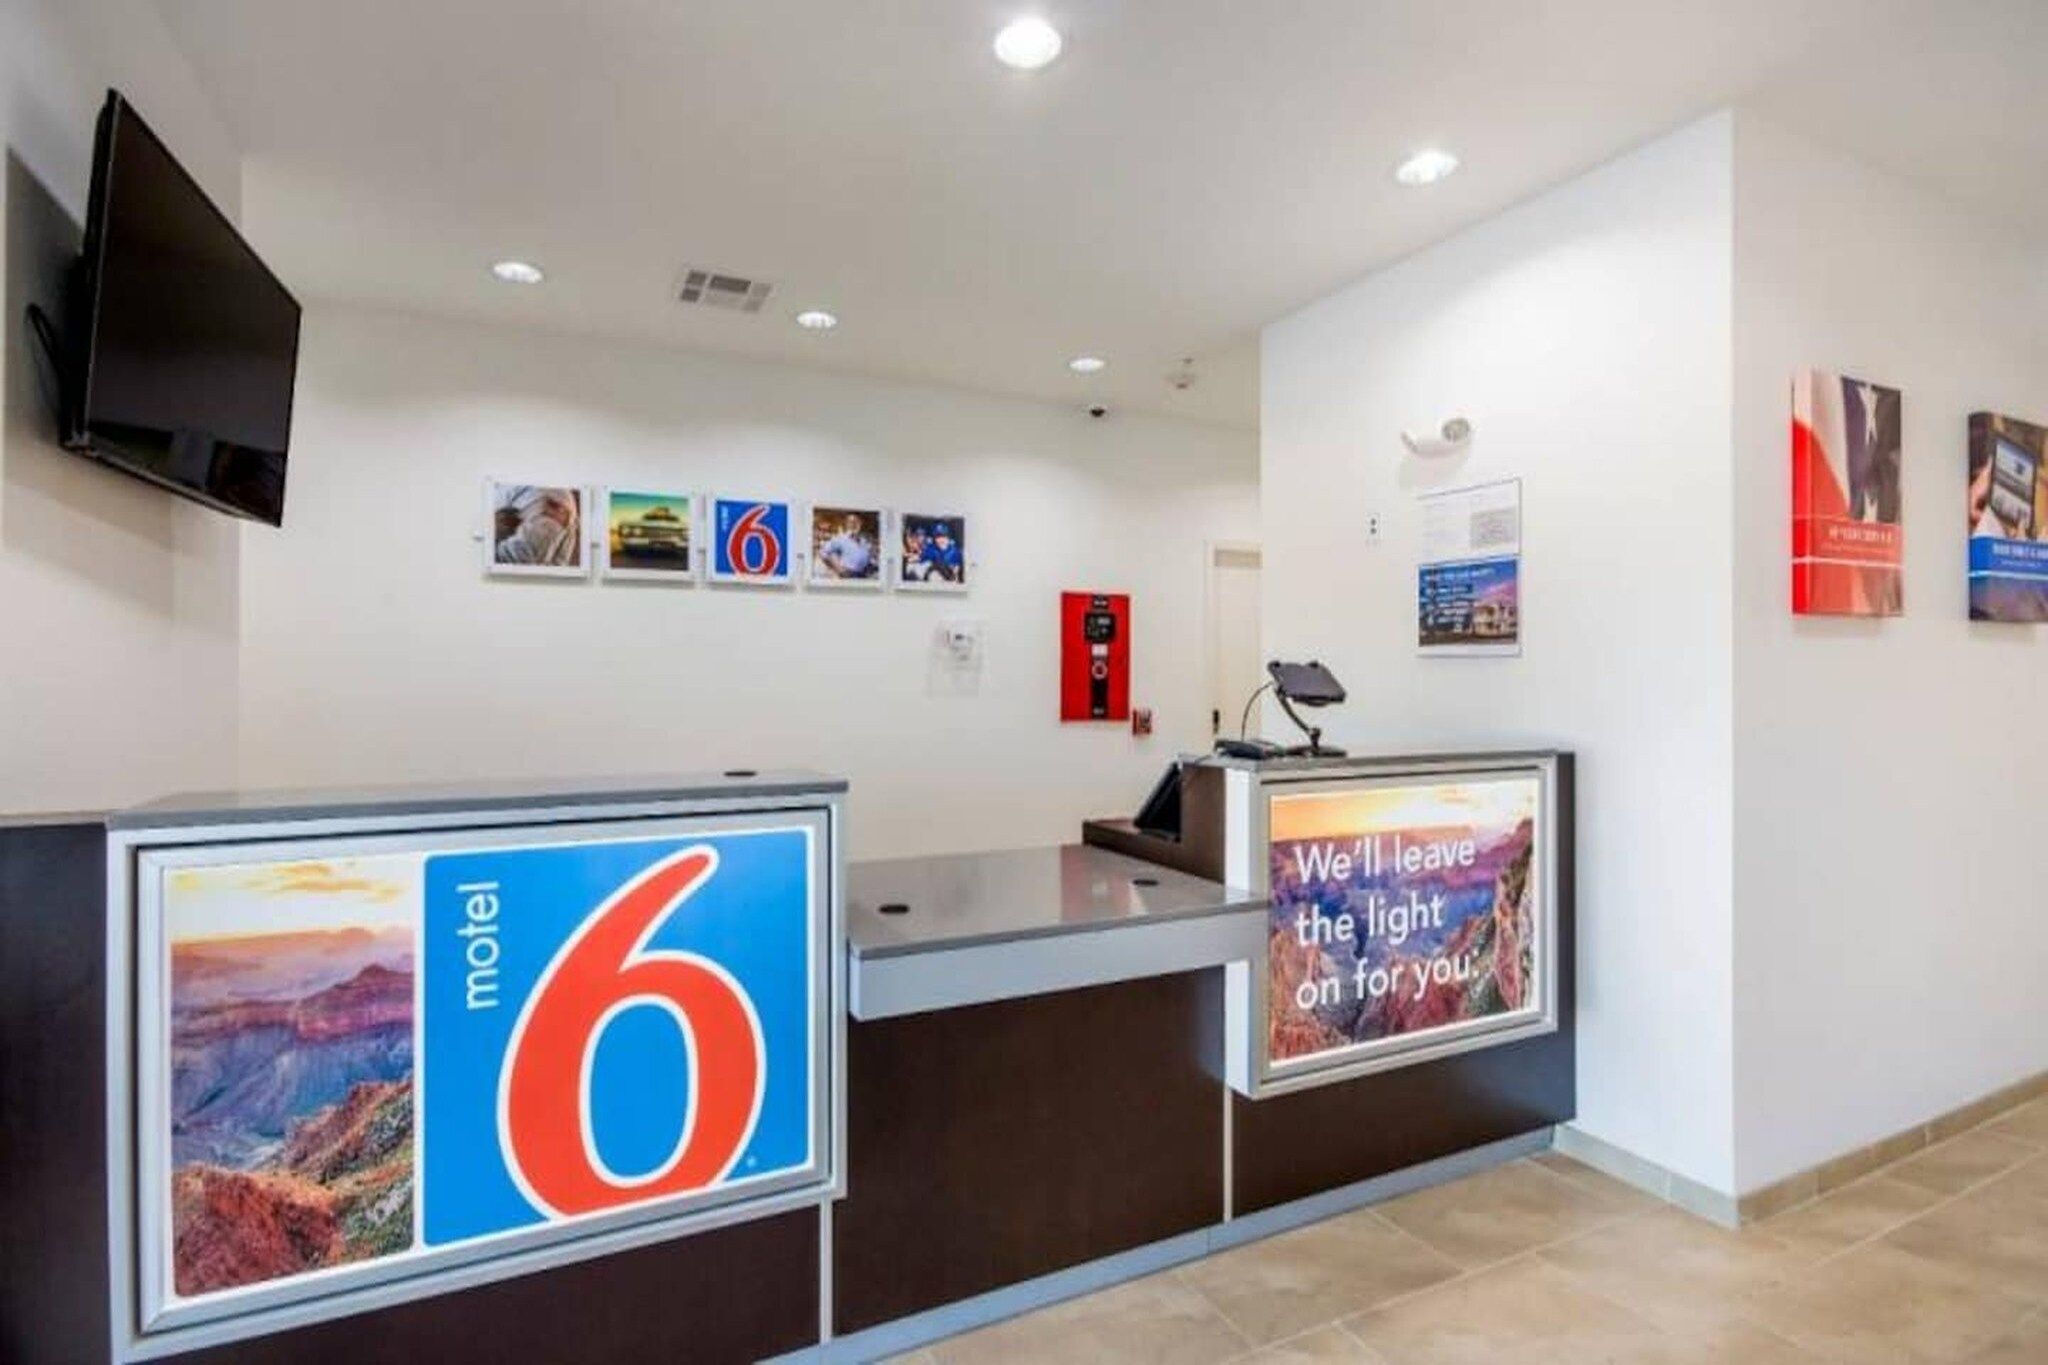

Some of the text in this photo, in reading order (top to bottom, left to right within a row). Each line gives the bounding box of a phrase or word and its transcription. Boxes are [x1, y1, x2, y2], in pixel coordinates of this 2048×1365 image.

[726, 504, 780, 578] 6
[1293, 834, 1475, 884] We'll leave
[1295, 890, 1445, 946] the light
[1296, 975, 1341, 1009] on
[1353, 957, 1404, 999] for
[456, 844, 767, 1222] motel 6
